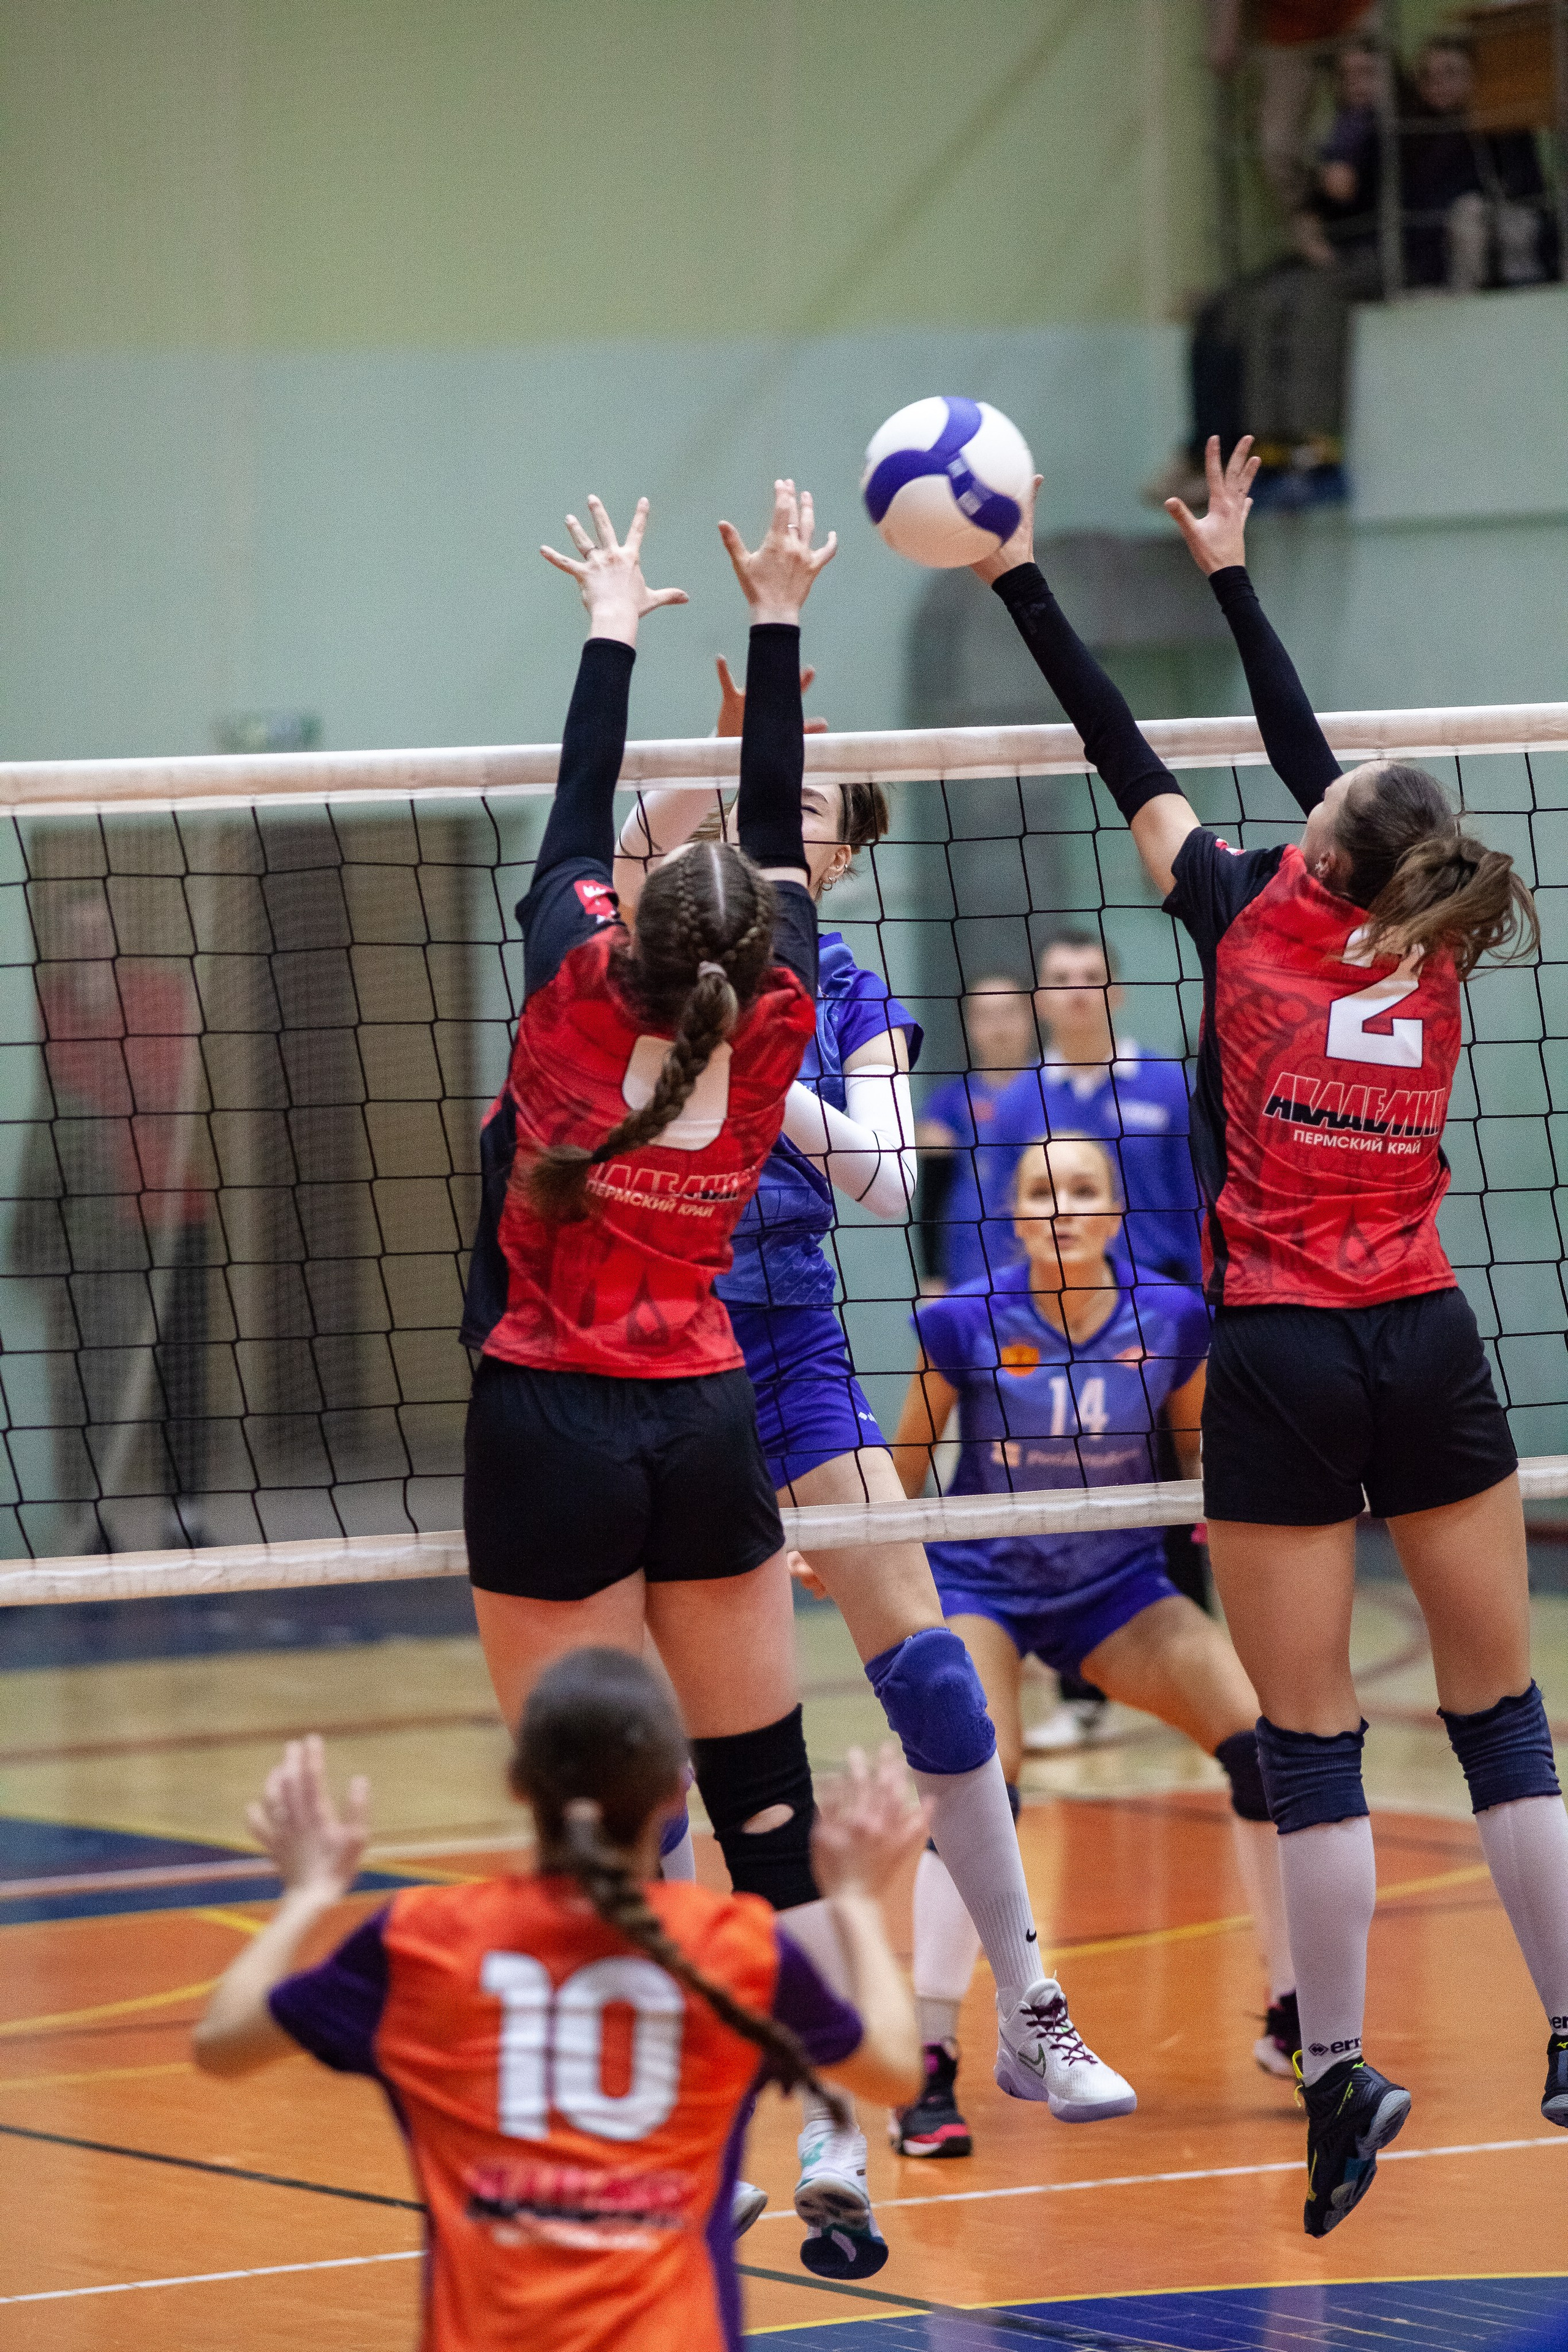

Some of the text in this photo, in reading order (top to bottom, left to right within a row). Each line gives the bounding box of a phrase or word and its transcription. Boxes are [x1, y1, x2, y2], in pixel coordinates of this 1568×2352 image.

[1325, 925, 1423, 1068] 2
[1293, 1129, 1422, 1154] ПЕРМСКИЙ КРАЙ
[1049, 1376, 1109, 1440] 14
[480, 1950, 685, 2141] 10
